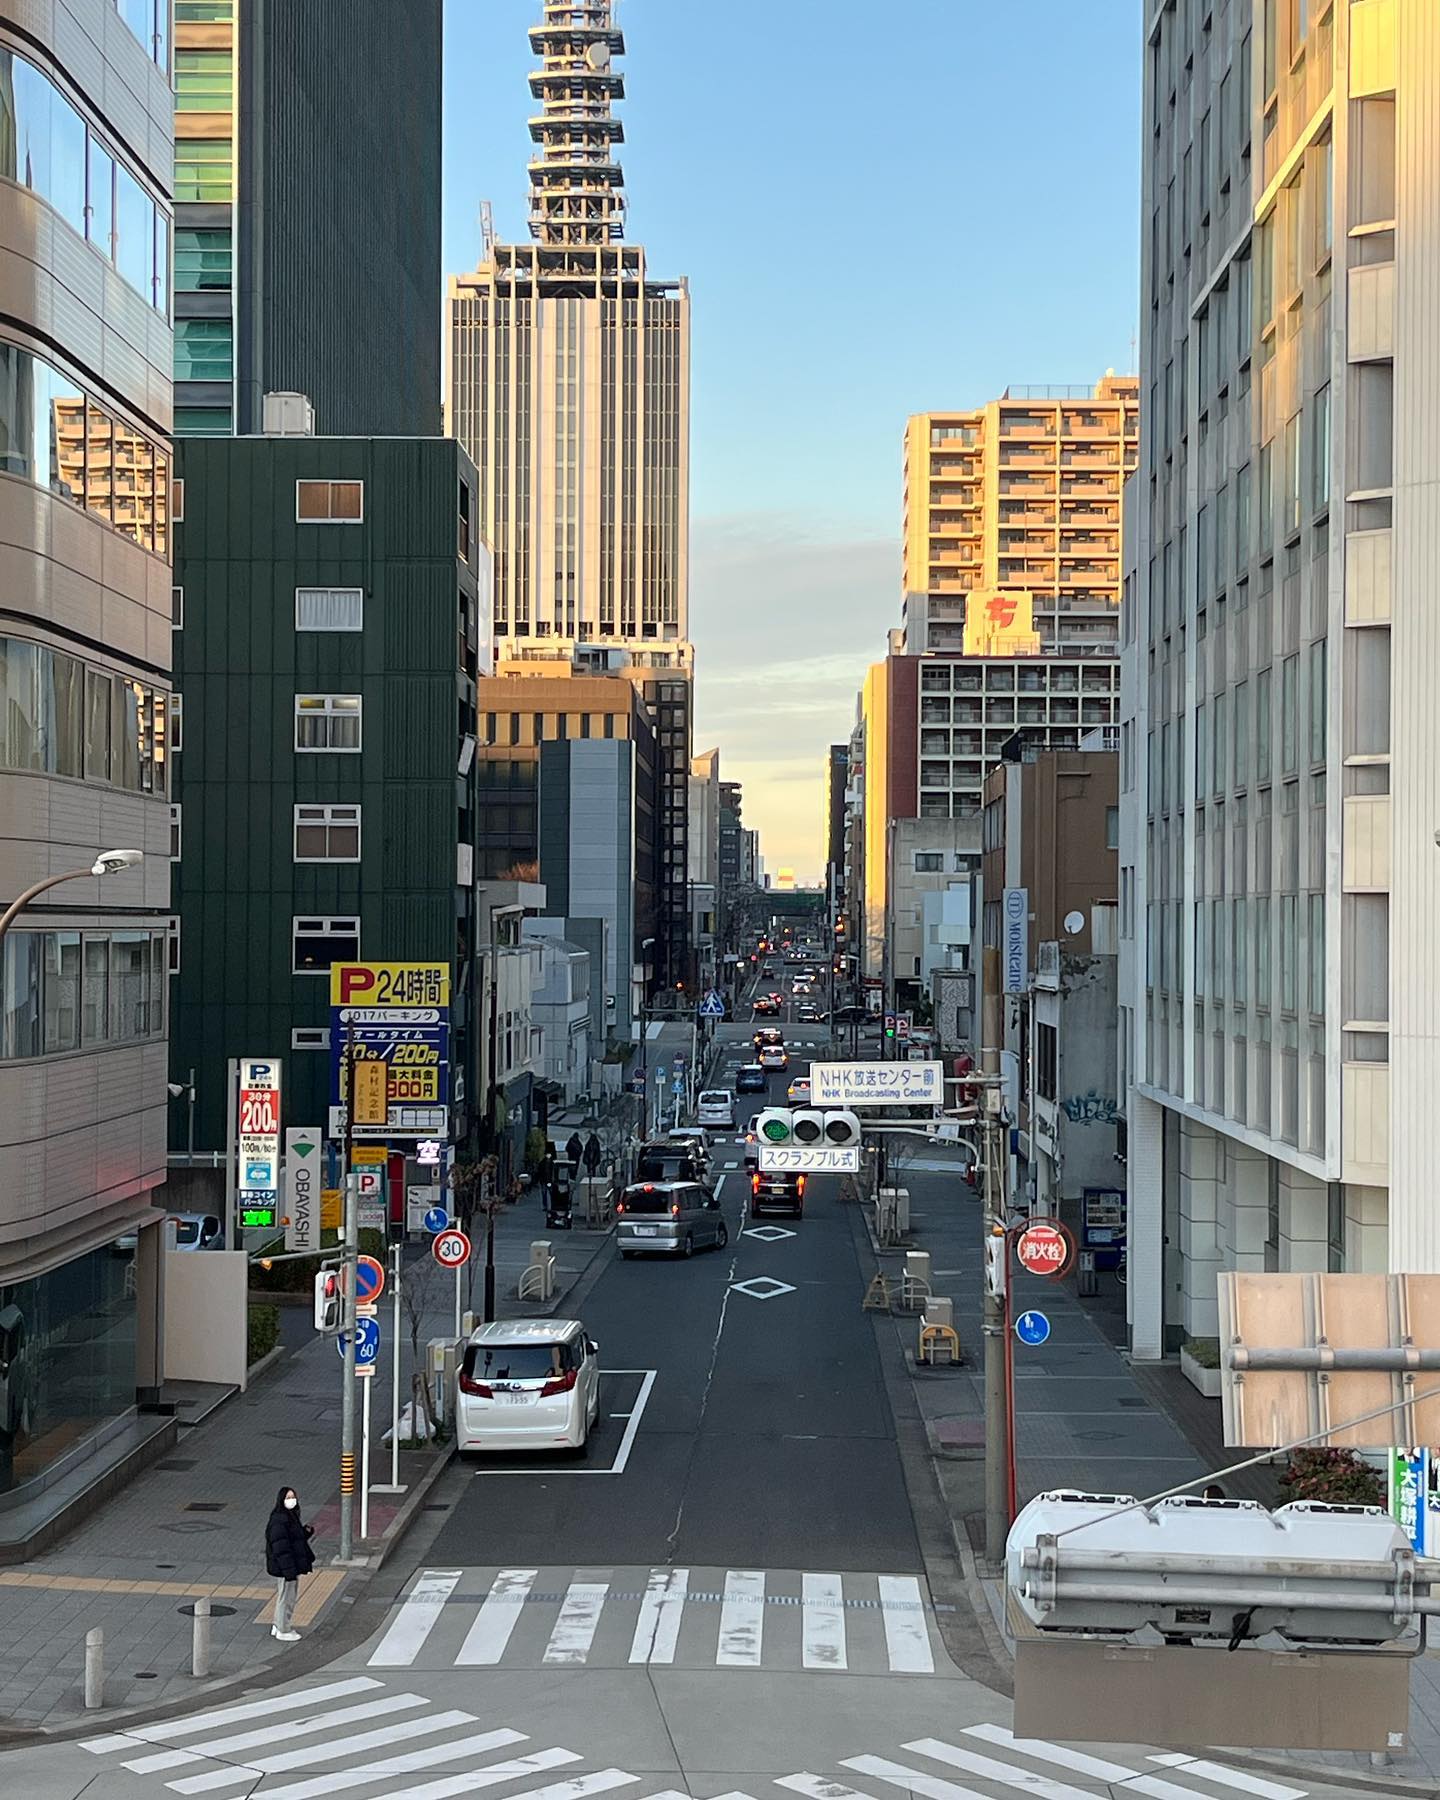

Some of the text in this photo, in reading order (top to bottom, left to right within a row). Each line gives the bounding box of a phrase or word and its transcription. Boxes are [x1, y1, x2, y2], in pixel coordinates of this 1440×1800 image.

[1009, 922, 1023, 992] Moisteane
[340, 967, 441, 1004] P 24時間
[250, 1064, 271, 1080] P
[820, 1069, 934, 1086] NHK放送センター前
[822, 1087, 932, 1099] NHK Broadcasting Center
[416, 1140, 440, 1164] 空
[764, 1151, 853, 1167] スクランブル式
[295, 1168, 310, 1247] OBAYASHI
[440, 1241, 462, 1257] 30
[1022, 1241, 1062, 1261] 消火栓
[360, 1343, 374, 1358] 60
